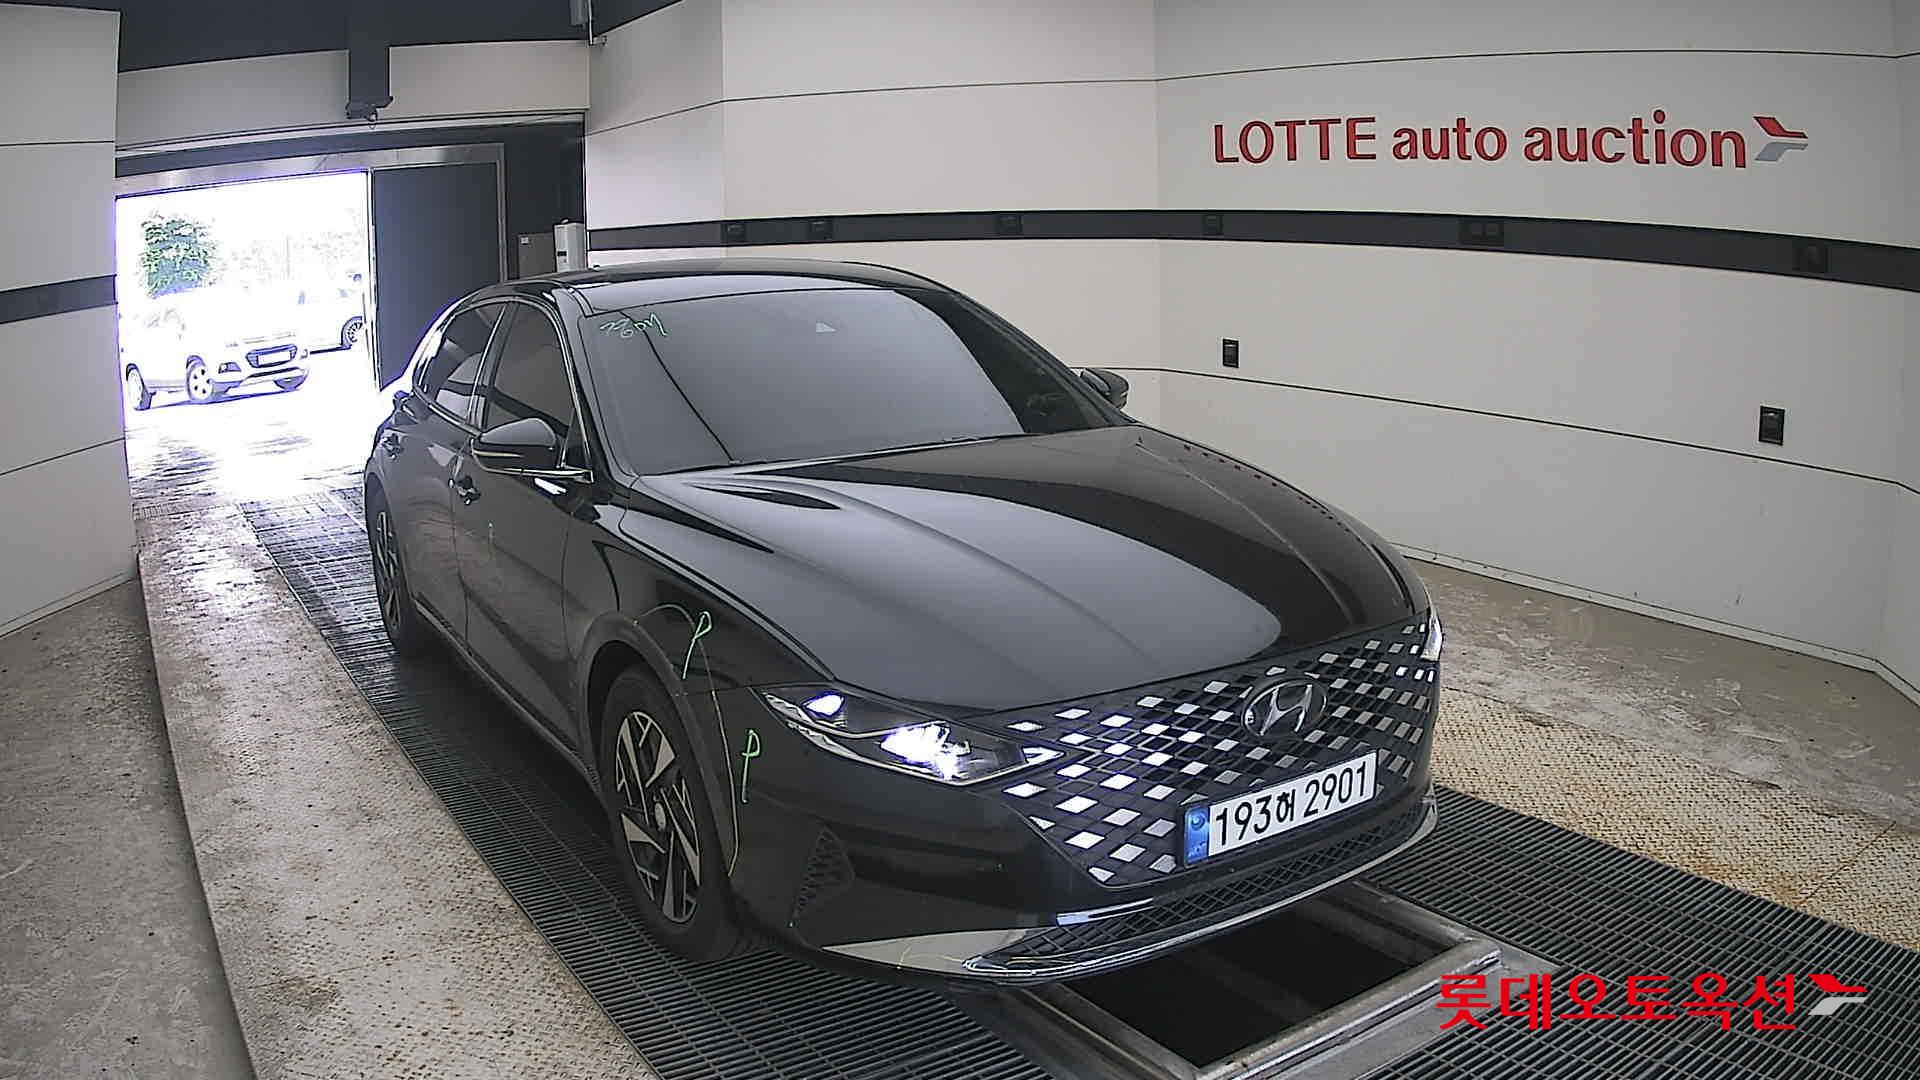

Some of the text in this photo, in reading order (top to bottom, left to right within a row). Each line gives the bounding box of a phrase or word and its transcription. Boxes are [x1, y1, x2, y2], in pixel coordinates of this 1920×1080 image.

[1214, 110, 1747, 168] LOTTE auto auction
[1215, 760, 1367, 846] 193허 2901
